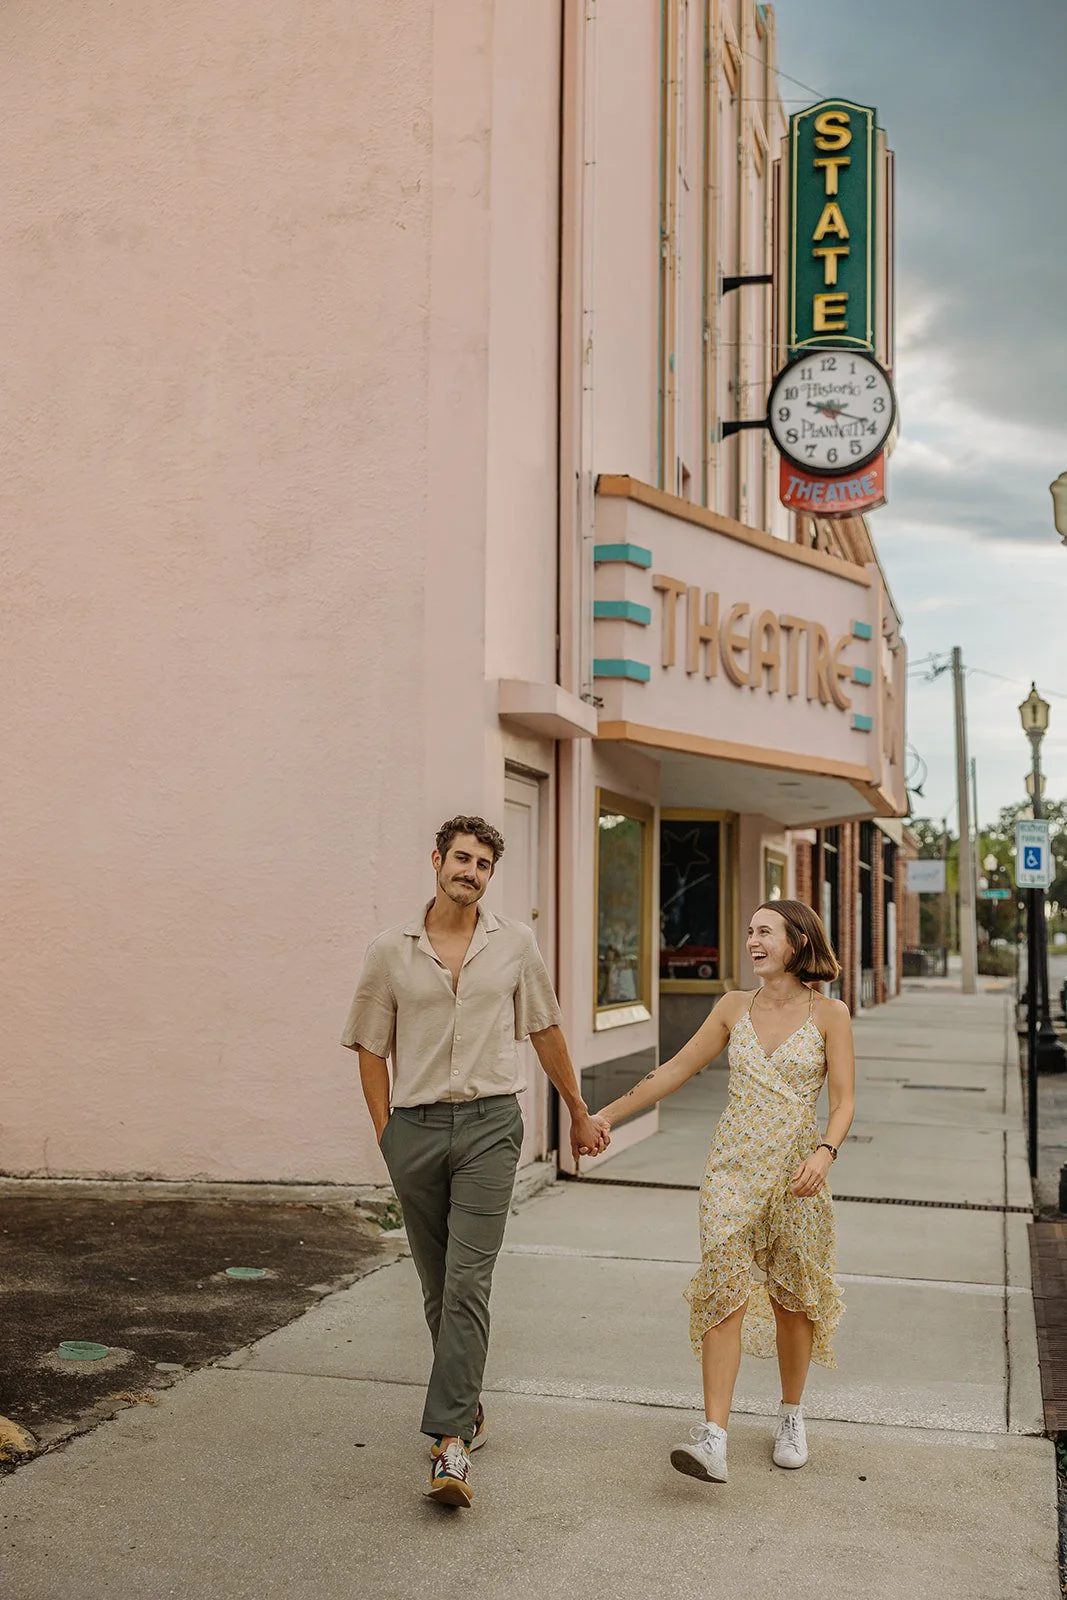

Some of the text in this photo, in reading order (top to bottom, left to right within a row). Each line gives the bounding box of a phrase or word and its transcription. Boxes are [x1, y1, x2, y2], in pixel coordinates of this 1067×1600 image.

[812, 110, 852, 332] STATE
[820, 357, 837, 371] 12
[850, 361, 856, 375] 1
[800, 368, 812, 380] 11
[865, 375, 877, 389] 2
[784, 387, 798, 400] 10
[873, 397, 885, 413] 3
[779, 407, 790, 422] 9
[867, 421, 877, 435] 4
[786, 428, 798, 444] 8
[805, 444, 817, 457] 7
[850, 440, 862, 455] 5
[827, 448, 838, 462] 6
[788, 475, 878, 502] THEATRE
[653, 574, 853, 711] THEATRE
